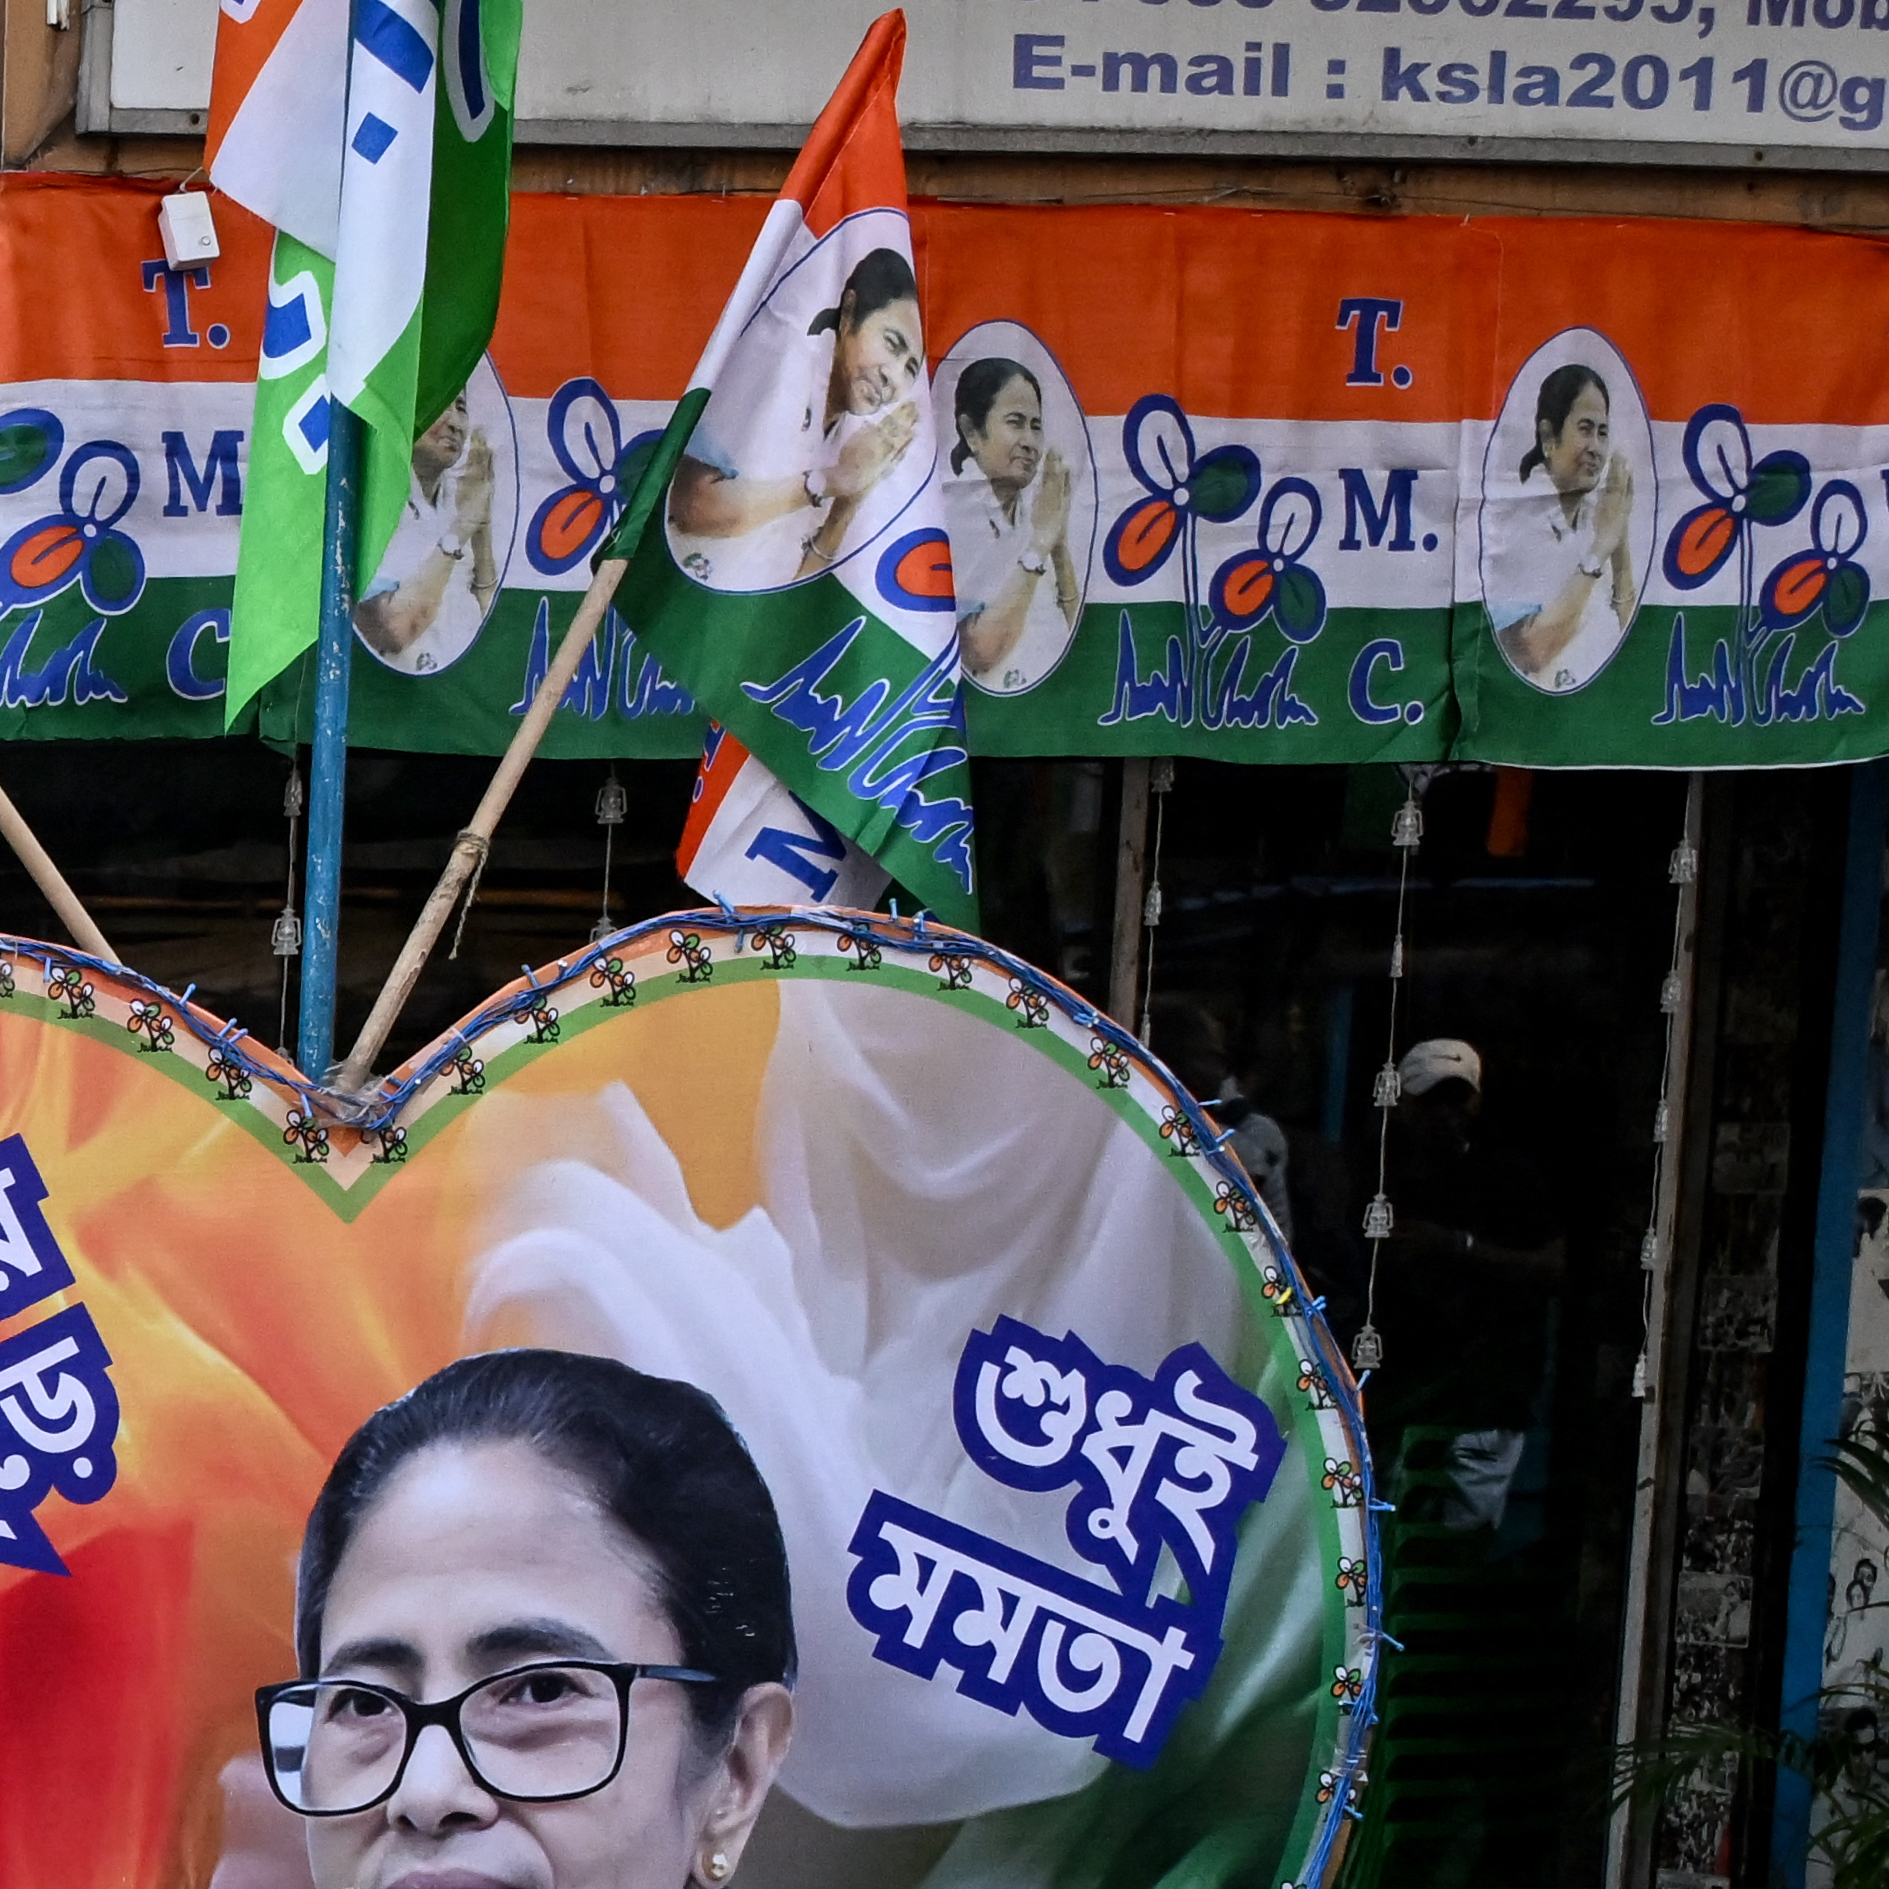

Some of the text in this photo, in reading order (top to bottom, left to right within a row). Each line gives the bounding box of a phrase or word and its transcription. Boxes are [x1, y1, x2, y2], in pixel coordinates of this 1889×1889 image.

[1013, 33, 1291, 99] E-mail
[1381, 47, 1887, 132] ksla2011@g
[1336, 297, 1413, 389] T.
[1338, 468, 1438, 552] M.
[1348, 639, 1424, 726] C.
[975, 1345, 1260, 1575] শুধুই
[868, 1521, 1196, 1744] মমতা
